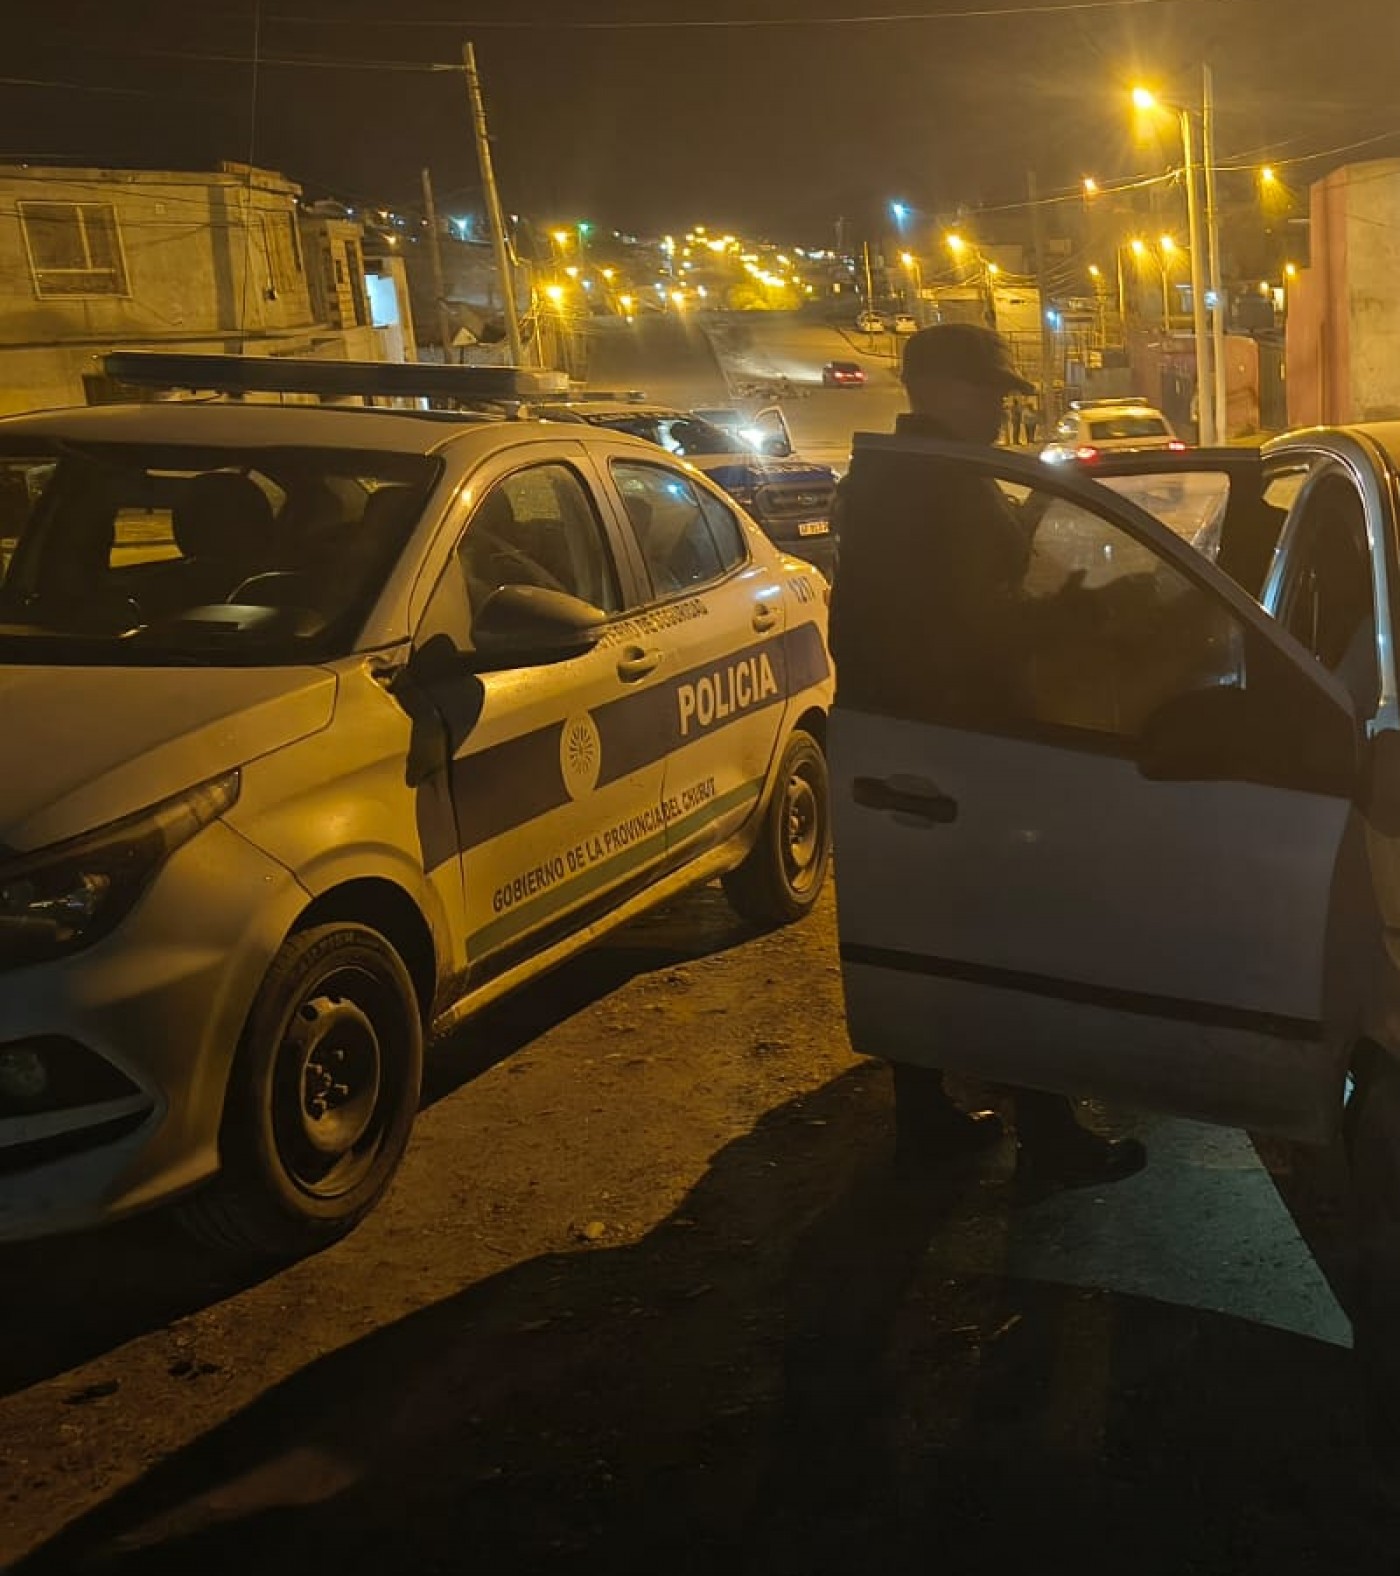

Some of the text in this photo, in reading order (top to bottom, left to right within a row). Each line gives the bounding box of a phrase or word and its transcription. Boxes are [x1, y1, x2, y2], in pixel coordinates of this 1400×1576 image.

[677, 651, 778, 735] POLICIA
[492, 857, 565, 912] GOBIERNO
[566, 846, 586, 873] DE
[586, 838, 605, 862] LA
[603, 806, 663, 852] PROVINCIA
[661, 796, 682, 821] DEL
